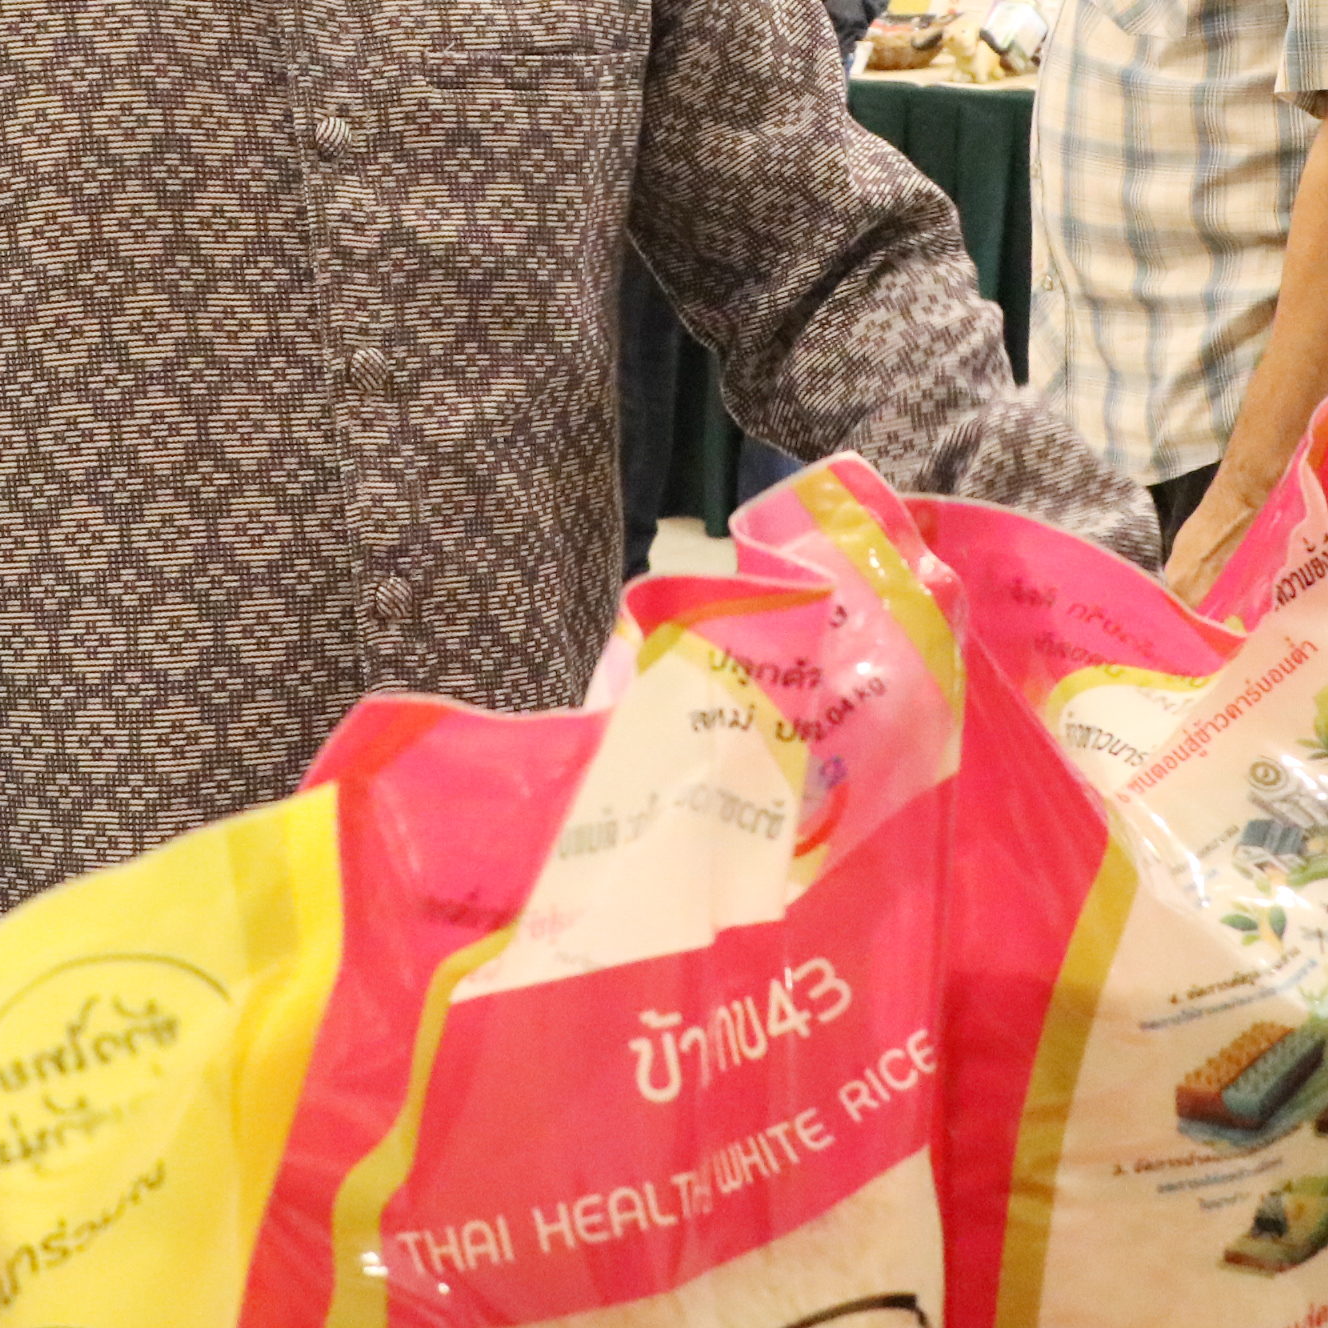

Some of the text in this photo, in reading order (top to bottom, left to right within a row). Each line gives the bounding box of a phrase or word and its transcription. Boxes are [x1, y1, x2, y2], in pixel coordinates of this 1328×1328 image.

[396, 1214, 517, 1277] THAI
[708, 1106, 836, 1197] WHITE
[838, 1028, 938, 1123] RICE
